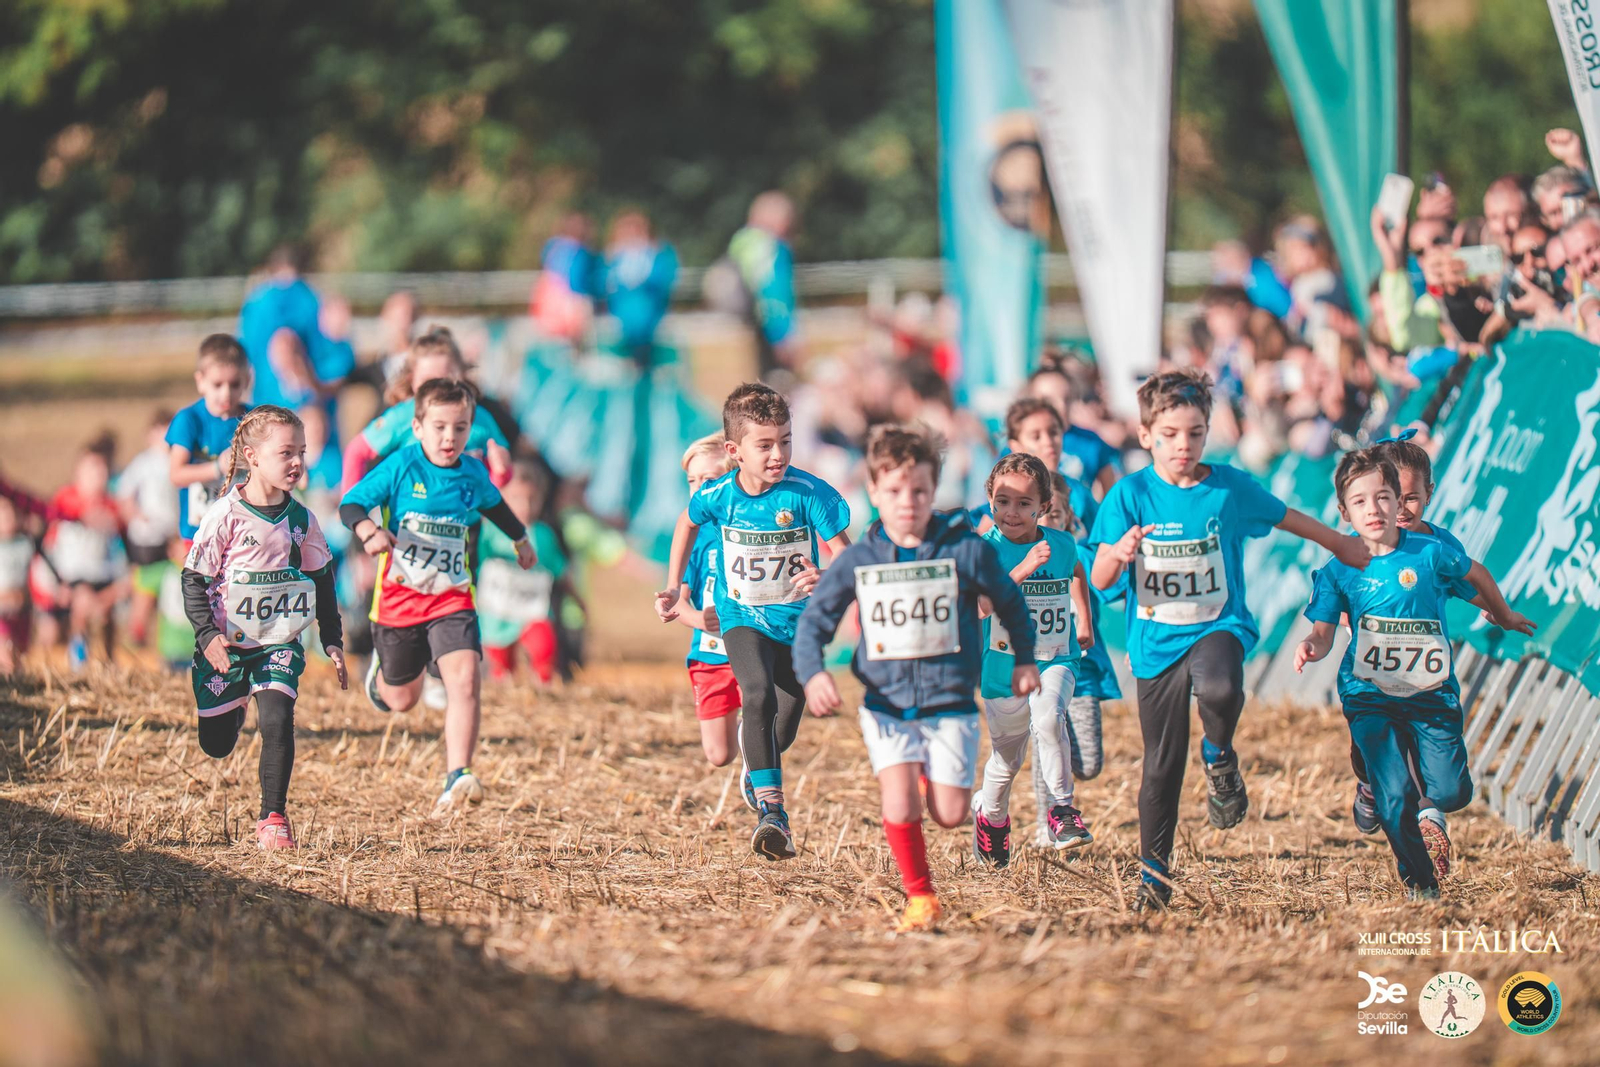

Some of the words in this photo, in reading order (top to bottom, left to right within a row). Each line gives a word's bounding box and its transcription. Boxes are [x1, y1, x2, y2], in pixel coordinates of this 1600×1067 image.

[745, 533, 788, 543] ITÁLICA
[402, 544, 462, 576] 4736
[731, 552, 806, 582] 4578
[255, 571, 295, 583] ITÁLICA
[1021, 582, 1057, 594] ITÁLICA
[1144, 566, 1221, 598] 4611
[236, 592, 310, 621] 4644
[871, 594, 950, 627] 4646
[1384, 621, 1427, 633] ITÁLICA
[1363, 645, 1443, 674] 4576
